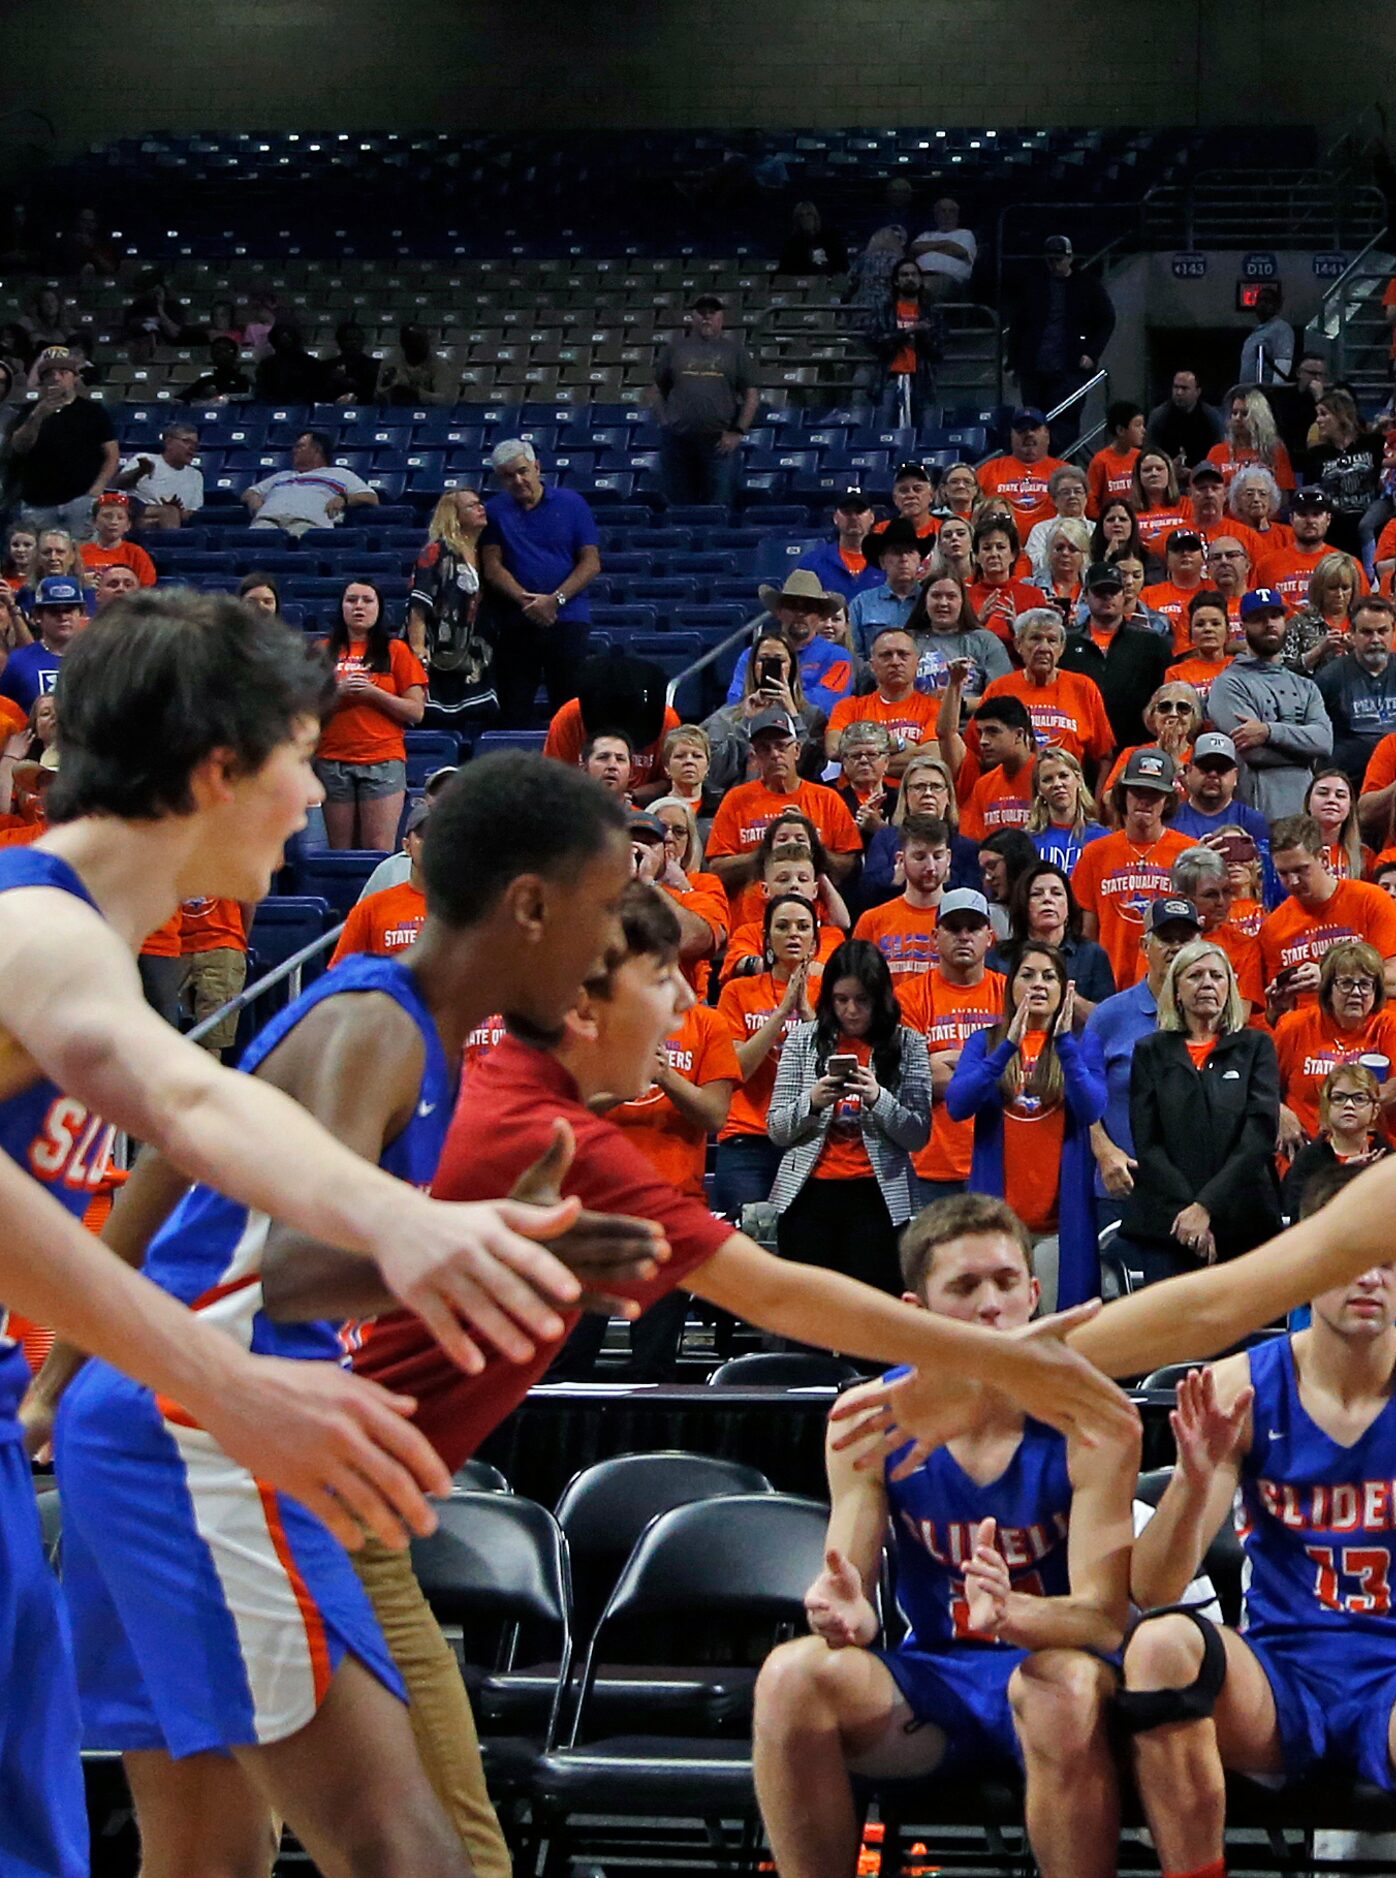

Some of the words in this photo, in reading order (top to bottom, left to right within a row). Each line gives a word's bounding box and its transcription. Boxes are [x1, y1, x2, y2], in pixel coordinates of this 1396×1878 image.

[1183, 263, 1204, 275] 143
[1247, 263, 1272, 275] D10
[1315, 263, 1338, 275] 144
[1256, 588, 1270, 602] T
[1101, 877, 1128, 896] STATE
[385, 930, 418, 947] STATE
[1282, 945, 1309, 967] STATE
[1305, 1544, 1392, 1615] 13
